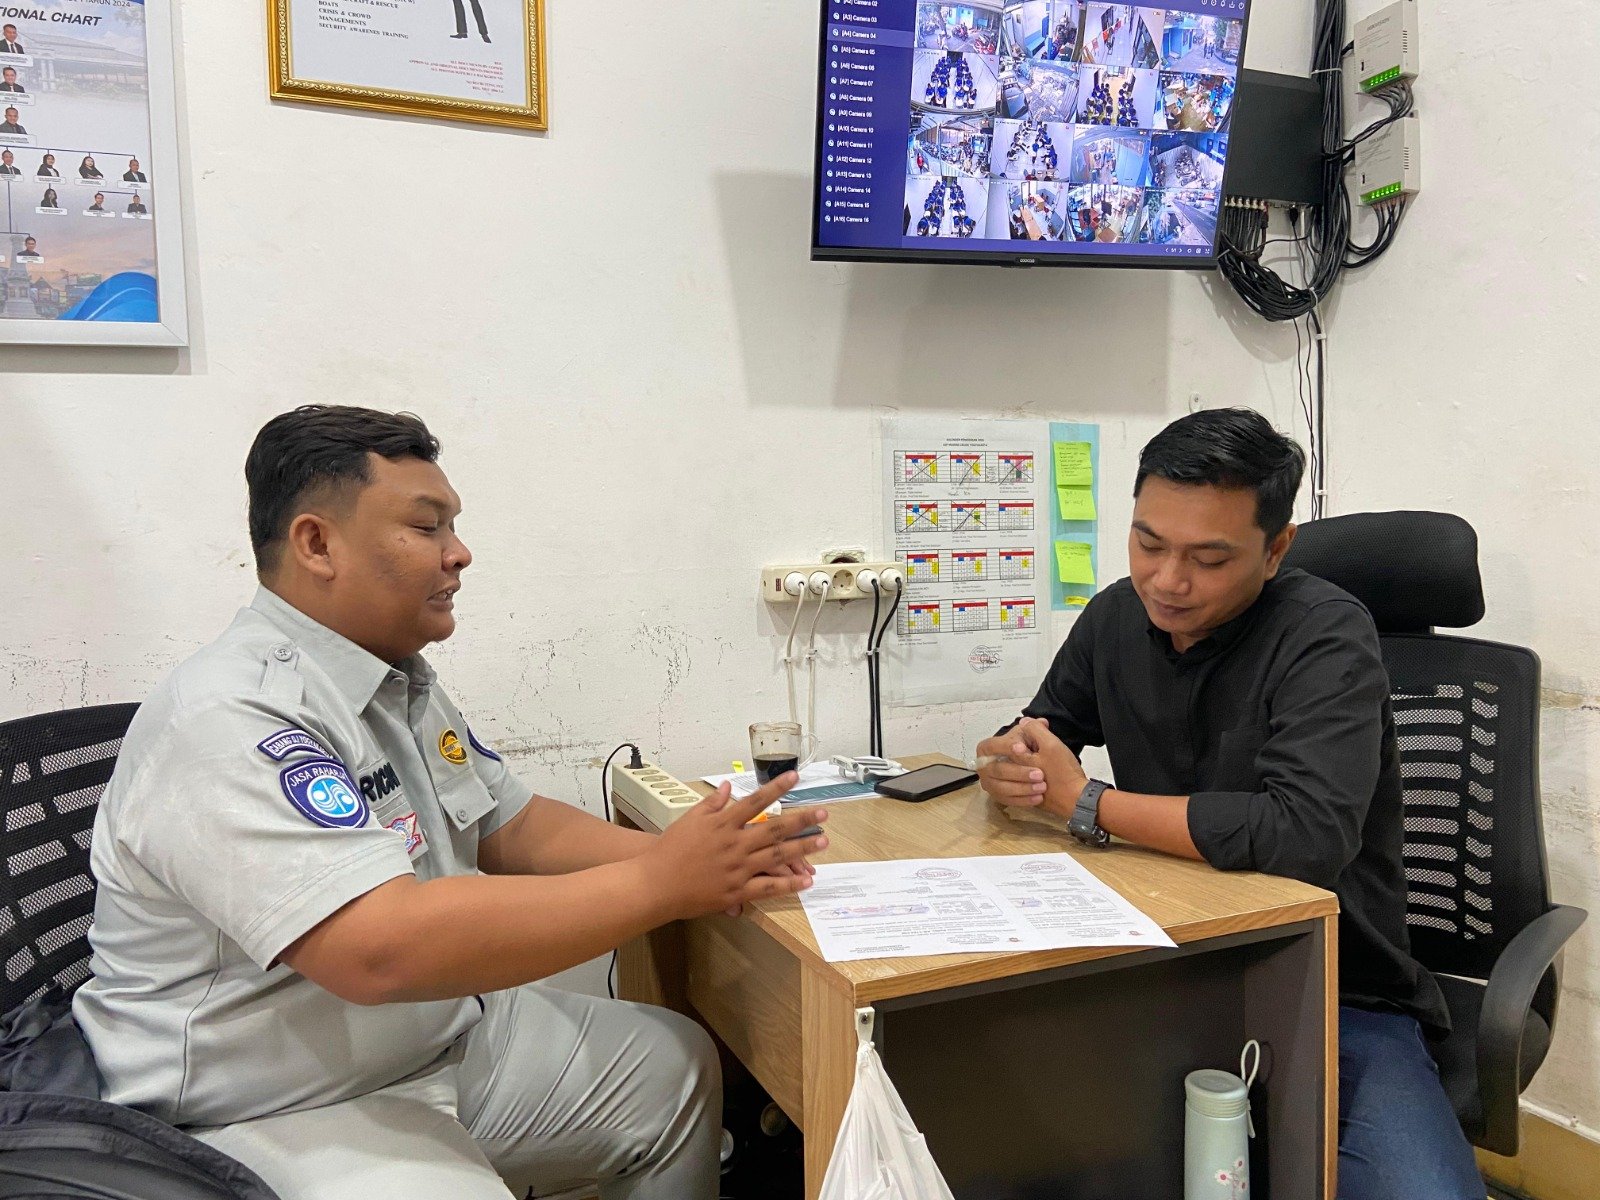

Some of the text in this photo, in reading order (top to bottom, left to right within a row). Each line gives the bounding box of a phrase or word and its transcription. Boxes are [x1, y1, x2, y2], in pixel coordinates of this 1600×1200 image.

[0, 6, 102, 26] IONAL CHART
[319, 15, 367, 26] MANAGEMENTS
[290, 767, 346, 786] JASA RAHARJA
